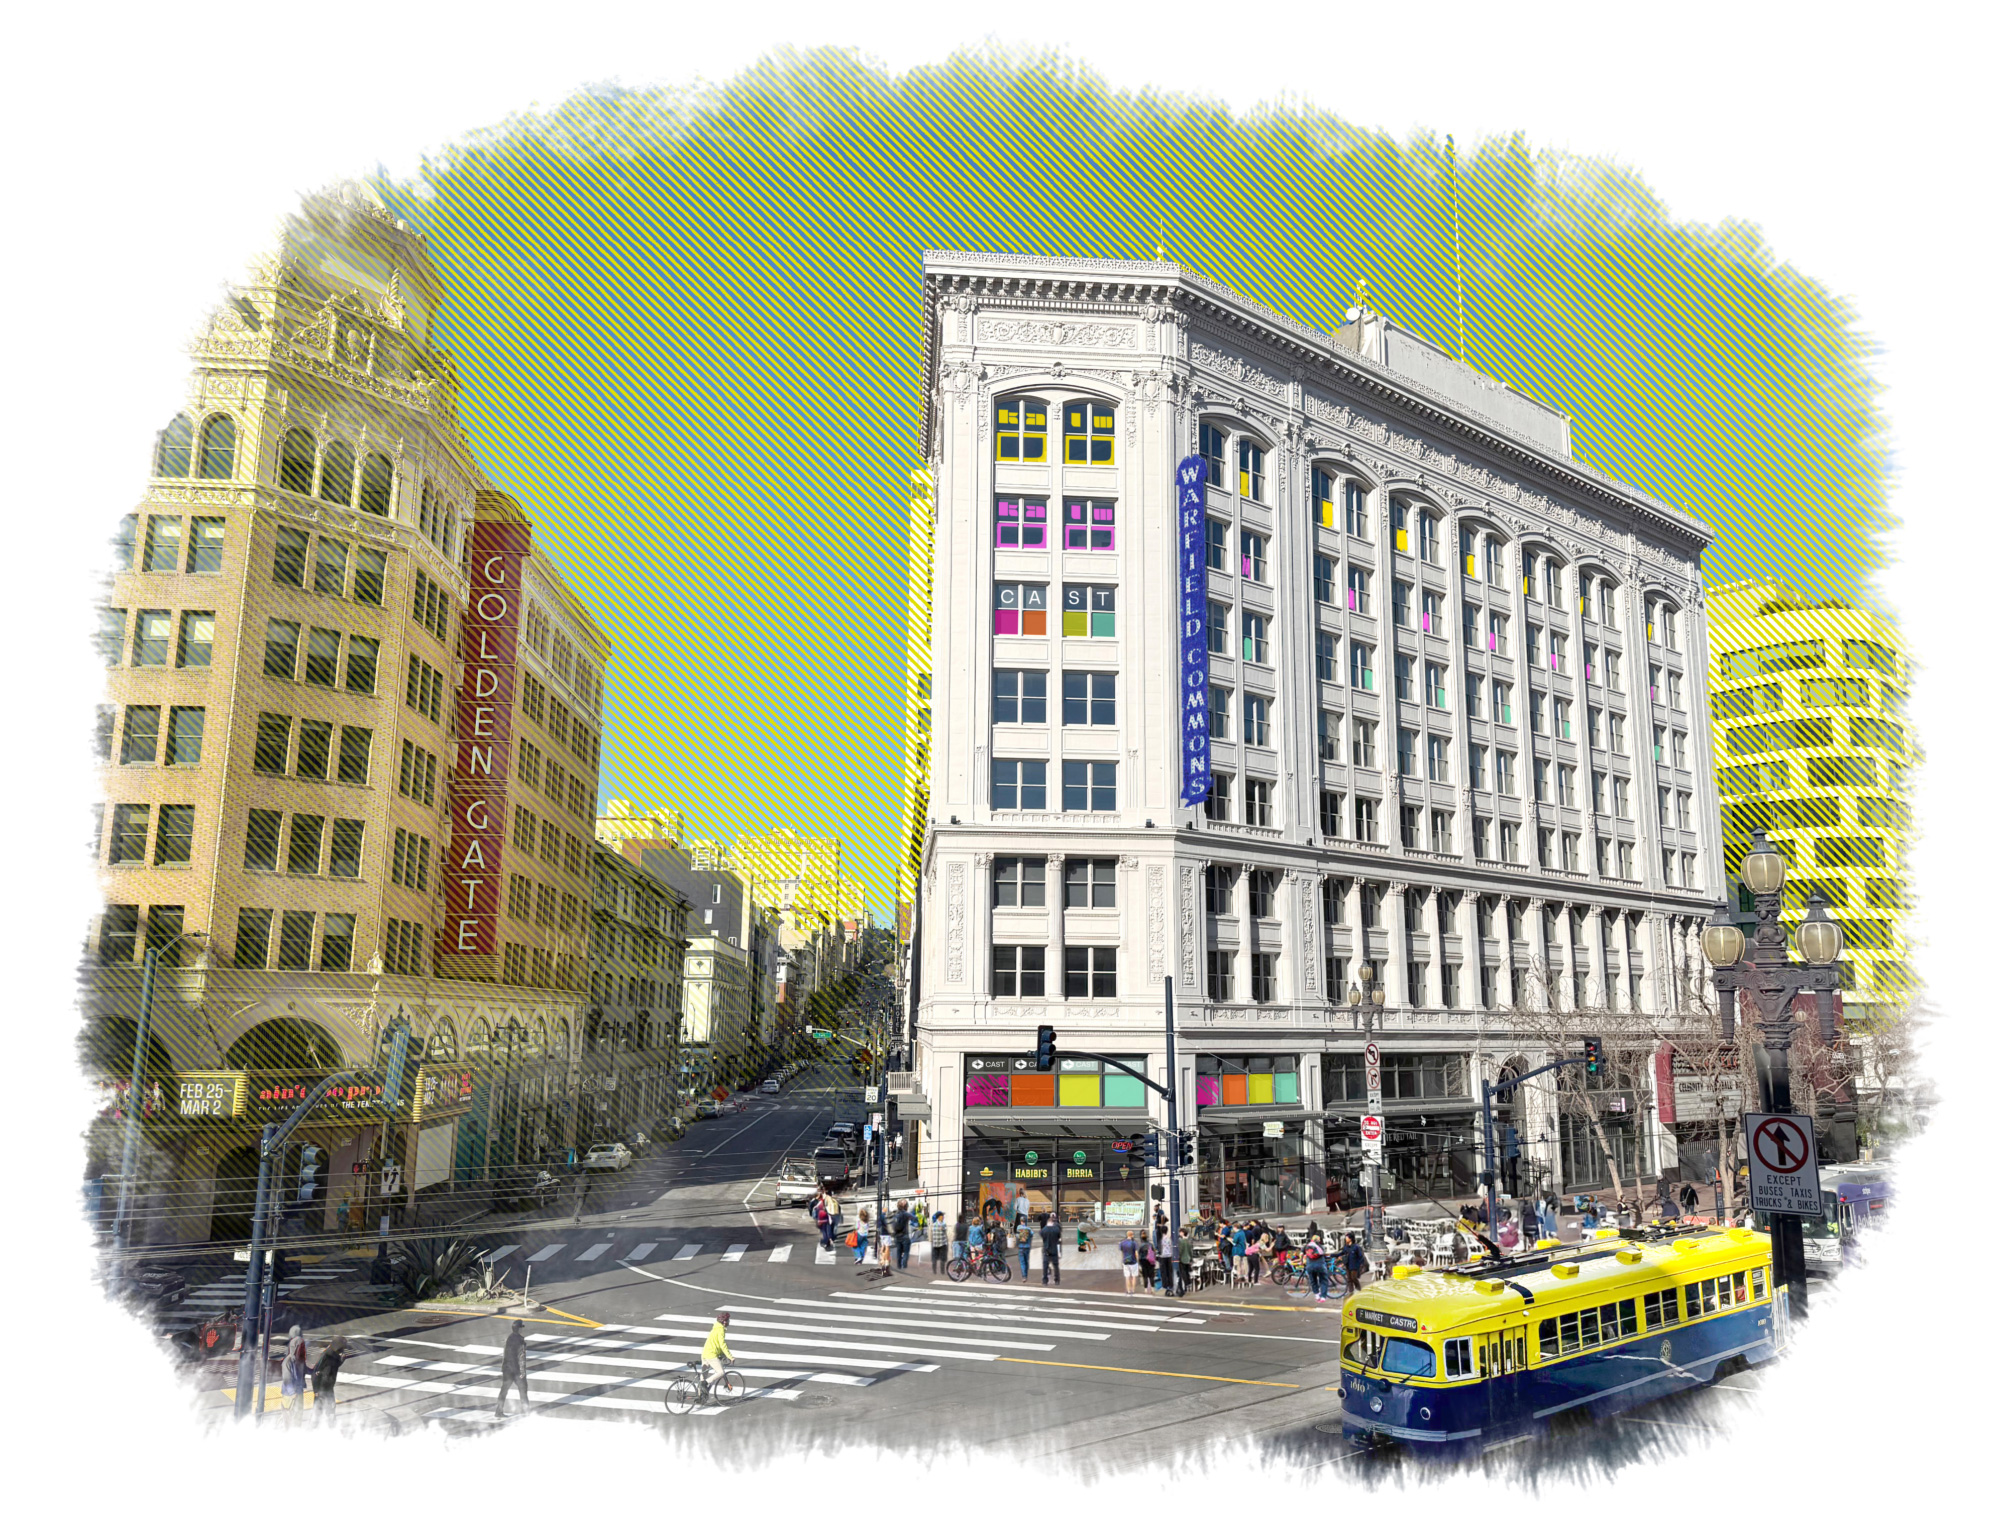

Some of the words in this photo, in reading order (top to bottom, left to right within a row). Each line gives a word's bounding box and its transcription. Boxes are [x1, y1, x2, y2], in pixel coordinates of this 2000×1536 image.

[1181, 465, 1201, 638] WARFIELD
[470, 556, 507, 775] GOLDEN
[1186, 648, 1206, 795] COMMONS
[458, 800, 488, 950] GATE
[180, 1083, 203, 1098] FEB
[180, 1100, 210, 1115] MAR
[212, 1100, 221, 1115] 2
[341, 1101, 355, 1109] THE
[1111, 1141, 1133, 1151] OPEN
[1015, 1168, 1048, 1178] HABIBI'S
[1067, 1168, 1093, 1178] BIRRIA
[1766, 1174, 1802, 1186] EXCEPT
[1758, 1186, 1783, 1197] BUSES
[1790, 1187, 1813, 1199] TAXIS
[1755, 1196, 1782, 1208] TRUCKS
[1787, 1200, 1793, 1209] &
[1797, 1200, 1819, 1211] BIKES
[1364, 1310, 1384, 1322] MARKET
